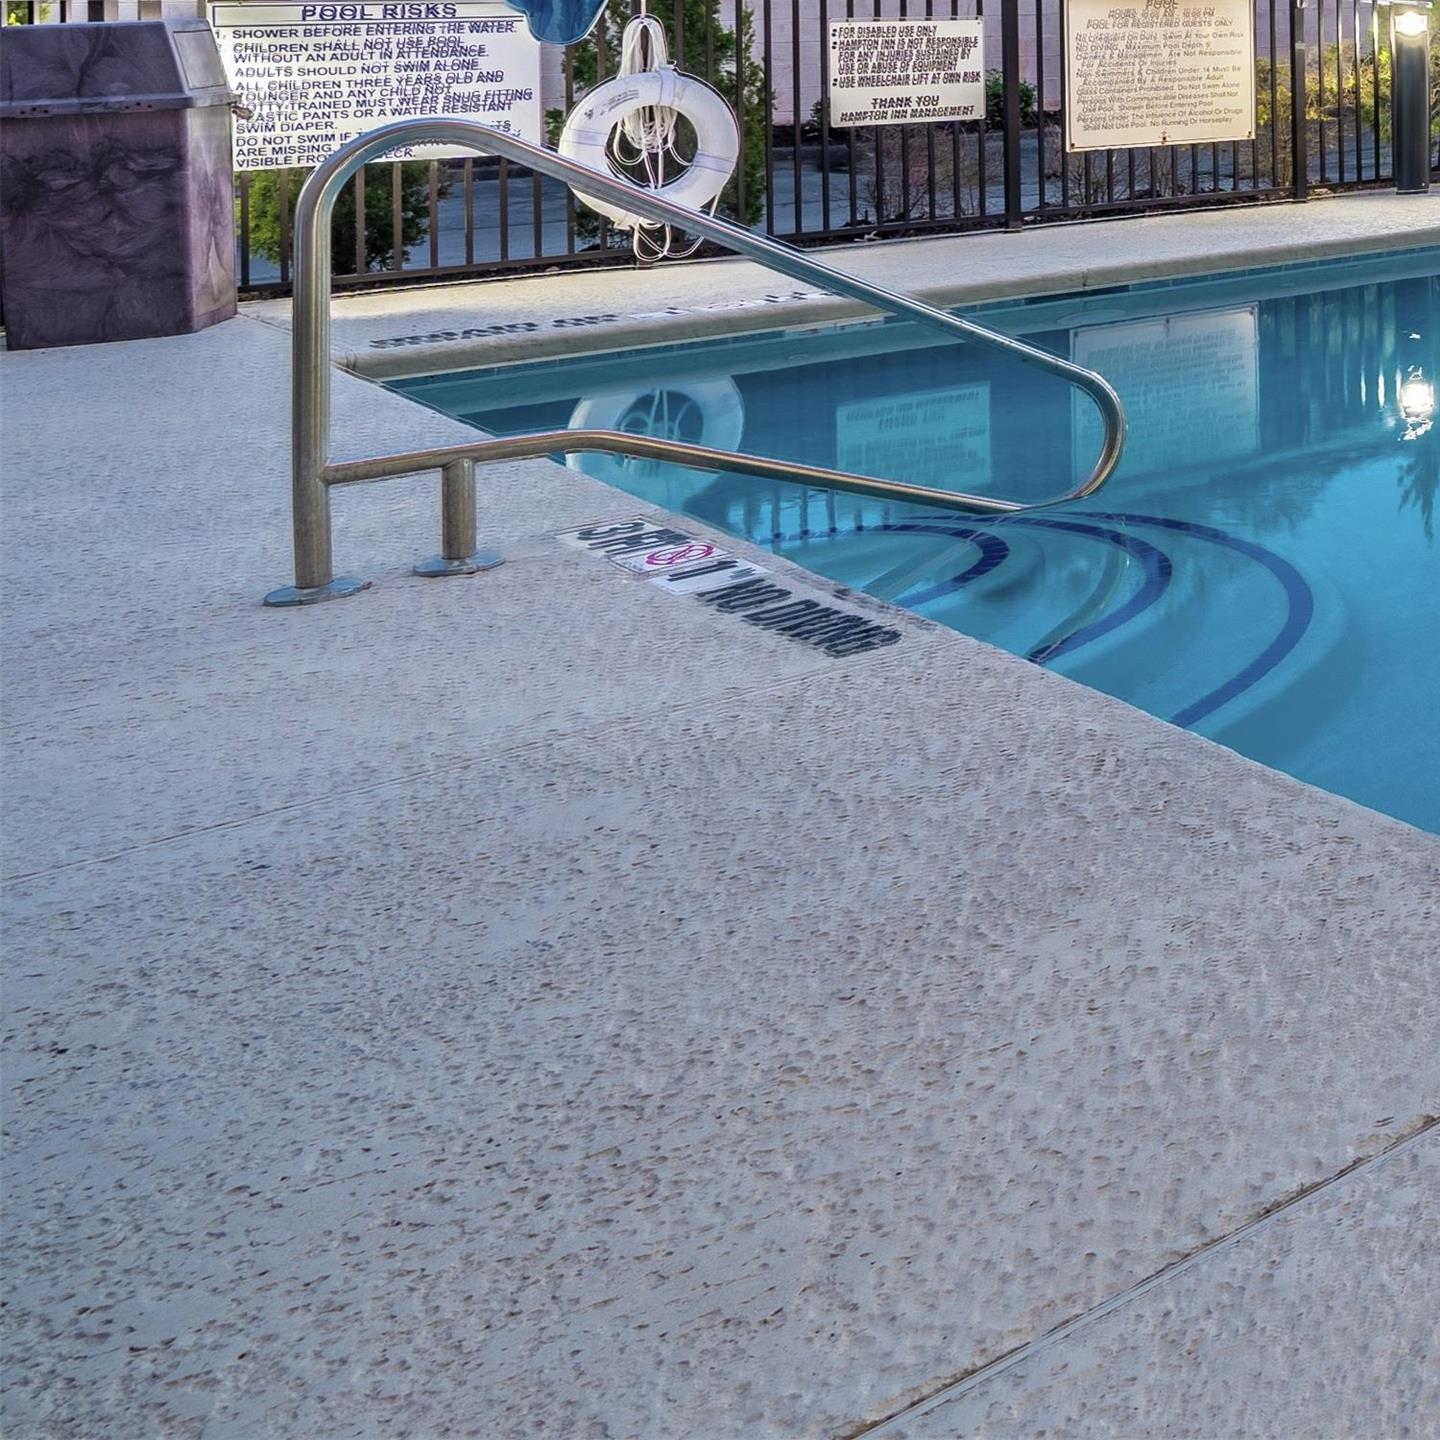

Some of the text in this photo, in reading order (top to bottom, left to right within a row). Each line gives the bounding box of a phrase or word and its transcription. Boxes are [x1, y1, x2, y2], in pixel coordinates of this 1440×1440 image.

[302, 3, 457, 21] POOL RISKS
[232, 29, 299, 39] SHOWER
[303, 25, 361, 38] BEFORE
[366, 22, 435, 36] ENTERING
[440, 21, 465, 34] THE
[468, 20, 517, 33] WATER.
[839, 25, 937, 38] FOR DISABLED USE ONLY
[233, 42, 308, 54] CHILDREN
[313, 39, 360, 52] SHALL
[364, 38, 393, 51] NOT
[396, 36, 423, 50] USE
[428, 35, 465, 48] POOL
[839, 36, 978, 51] HAMPTON INN IS NOT RESPONSIBLE
[234, 52, 303, 64] WITHOUT
[306, 53, 326, 62] AN
[329, 50, 376, 62] ADULT
[379, 48, 393, 60] IN
[839, 48, 971, 63] FOR ANY INJURIES SUSTAINED BY
[235, 66, 293, 77] ADULTS
[297, 66, 356, 77] SHOULD
[361, 62, 390, 74] NOT
[394, 60, 430, 73] SWIM
[839, 60, 958, 75] USE OR ABUSE OF EQUIPMENT
[235, 71, 504, 92] ALL CHILDREN THREE YEARS OLD AND
[839, 71, 981, 88] USE WHEELCHAIR LIFT AT OWN RISK
[313, 90, 343, 100] AND
[347, 88, 375, 99] ANY
[380, 86, 420, 98] CHILD
[424, 82, 452, 96] NOT
[355, 98, 394, 109] MUST
[398, 94, 440, 107] WEAR
[443, 91, 481, 104] SNUG
[484, 88, 533, 101] FITTING
[871, 95, 940, 109] THANK YOU
[237, 100, 513, 123] ASTIC PANTS OR A WATER RESISTANT
[840, 105, 975, 123] HAMPTON INN MANAGEMENT
[236, 121, 338, 134] SWIM DIAPER.
[236, 136, 257, 147] DO
[262, 135, 294, 146] NOT
[297, 132, 335, 143] SWIM
[339, 131, 352, 142] IF
[236, 147, 271, 157] ARE
[236, 155, 294, 168] VISIBLE
[297, 153, 328, 164] FRO
[695, 578, 792, 614] NO
